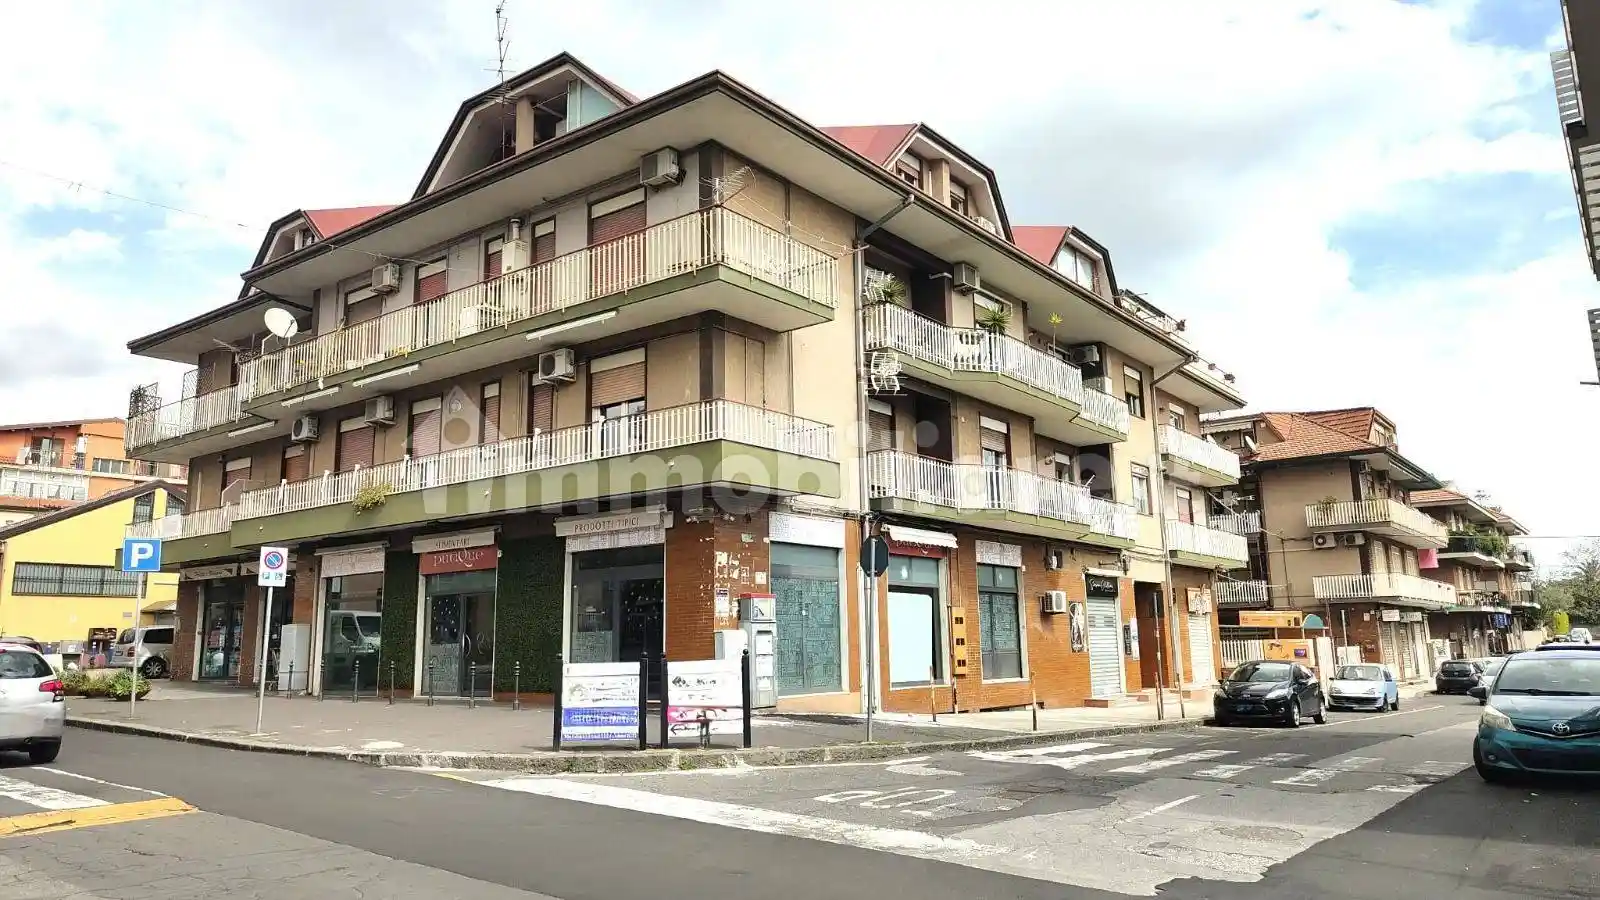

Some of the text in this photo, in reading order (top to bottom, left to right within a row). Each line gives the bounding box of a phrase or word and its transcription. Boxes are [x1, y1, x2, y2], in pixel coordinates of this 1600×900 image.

[574, 516, 640, 533] PRODOTTI TIPICI
[131, 542, 153, 568] P
